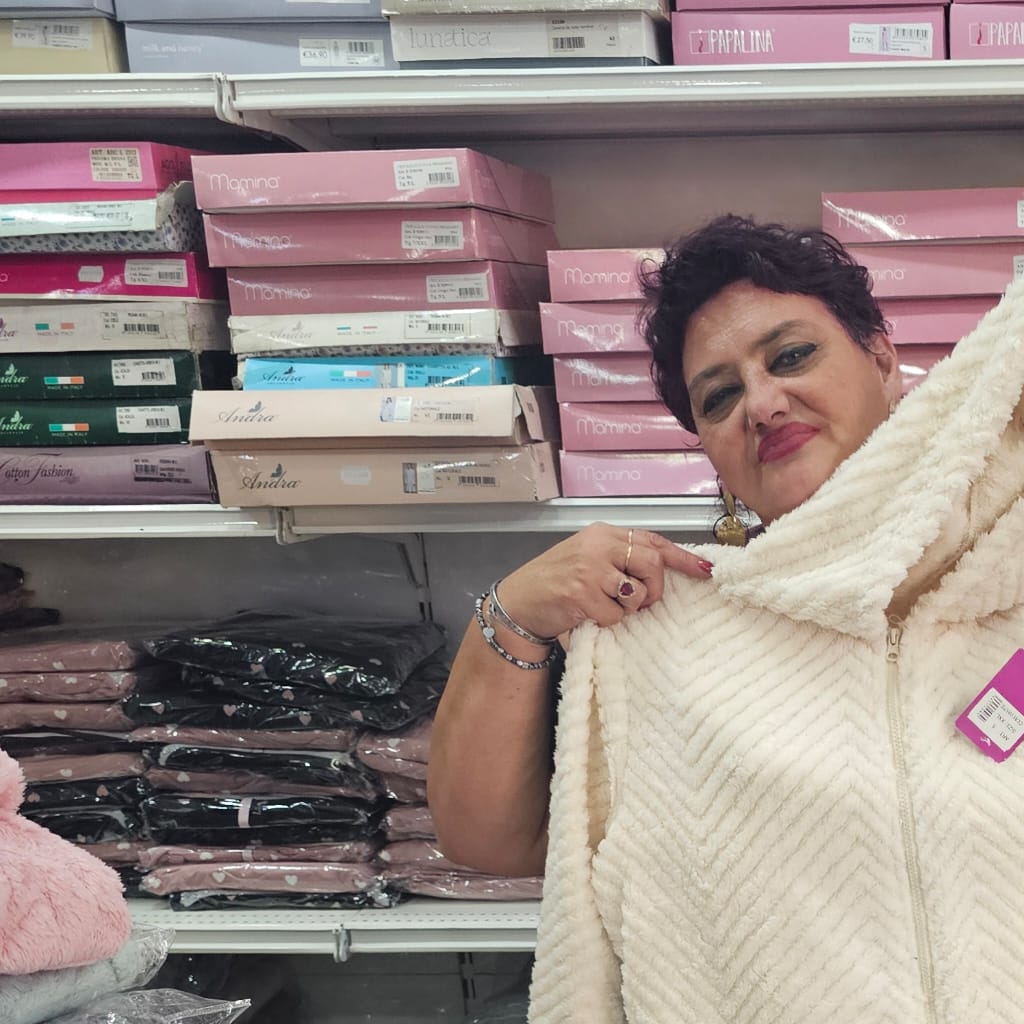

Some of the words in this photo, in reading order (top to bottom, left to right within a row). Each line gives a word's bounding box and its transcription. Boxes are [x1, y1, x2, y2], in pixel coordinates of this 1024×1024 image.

[710, 29, 774, 54] PAPALINA
[210, 174, 280, 191] Mamina
[564, 268, 631, 285] Mamina
[216, 405, 276, 423] Andra
[577, 417, 642, 434] Mamina
[240, 471, 300, 490] Andra
[577, 465, 641, 482] Mamina
